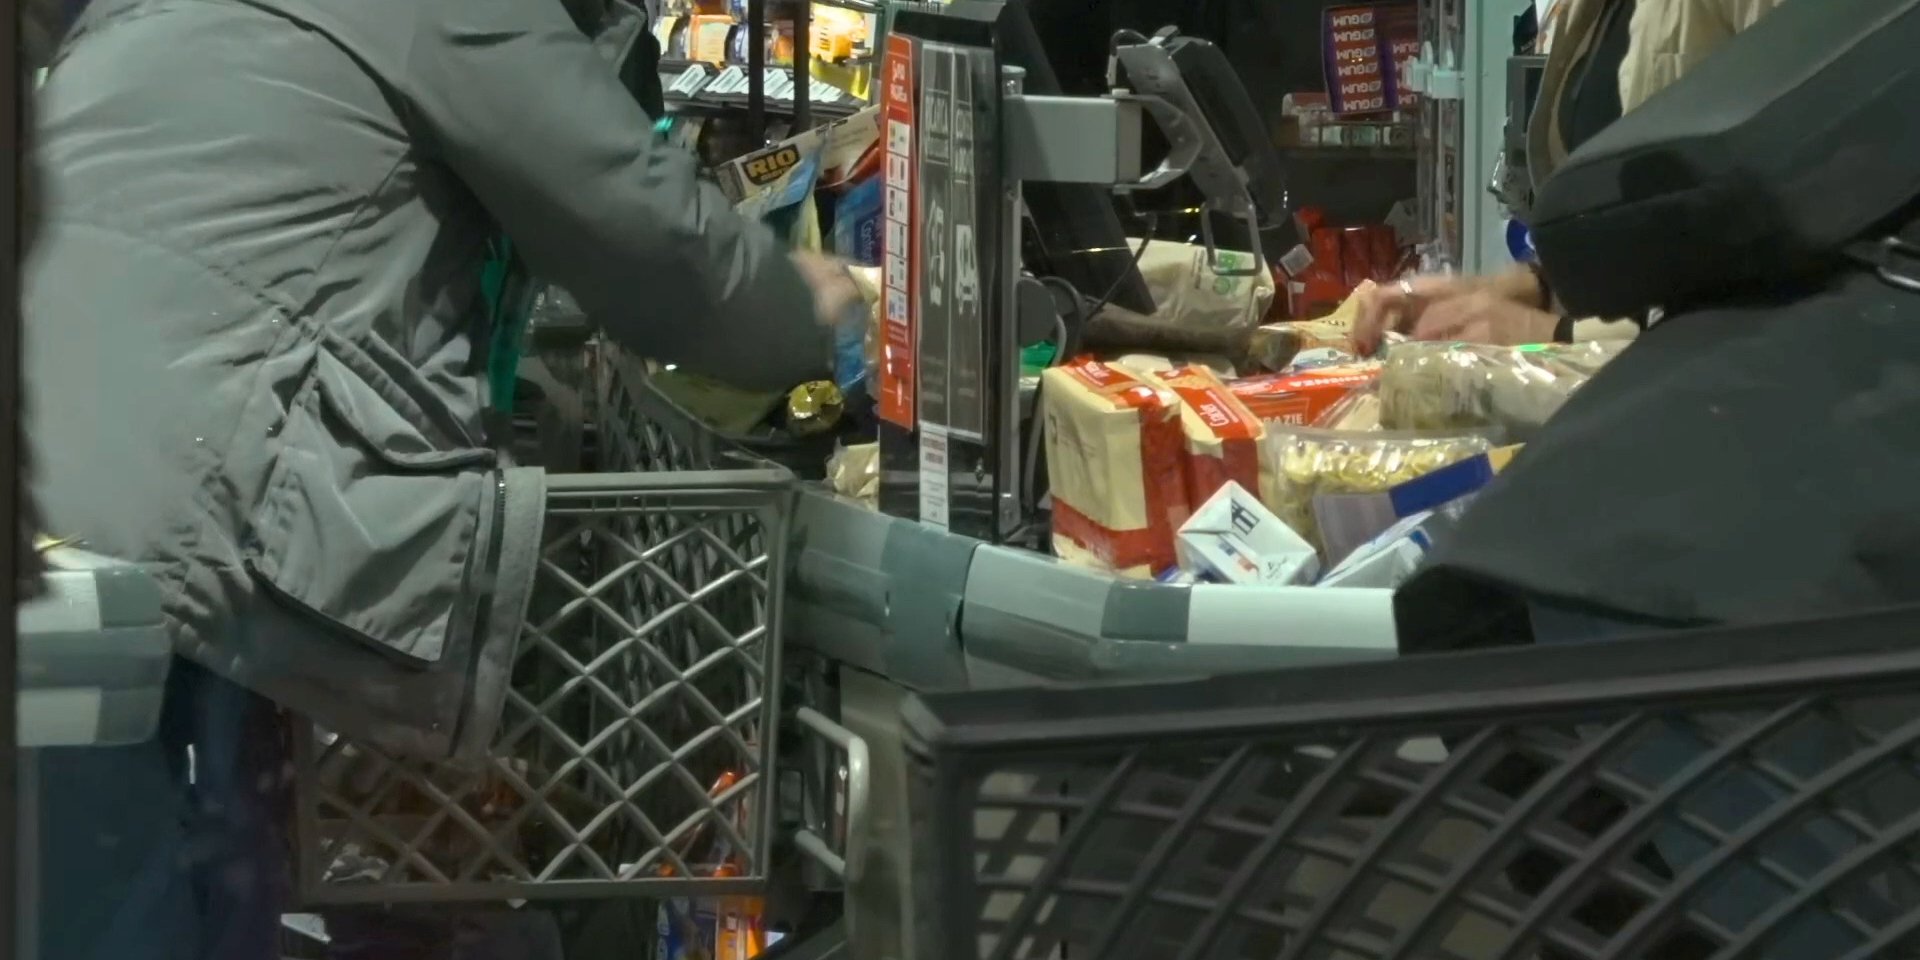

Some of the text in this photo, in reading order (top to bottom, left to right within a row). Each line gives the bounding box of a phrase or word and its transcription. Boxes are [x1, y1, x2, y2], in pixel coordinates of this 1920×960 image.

[1333, 14, 1360, 27] GUM
[1333, 30, 1361, 42] GUM
[1336, 48, 1363, 60] GUM
[1338, 64, 1365, 76] GUM
[1341, 82, 1368, 94] GUM
[1343, 99, 1370, 111] GUM
[745, 149, 796, 178] RIO
[1262, 412, 1303, 425] RAZIE
